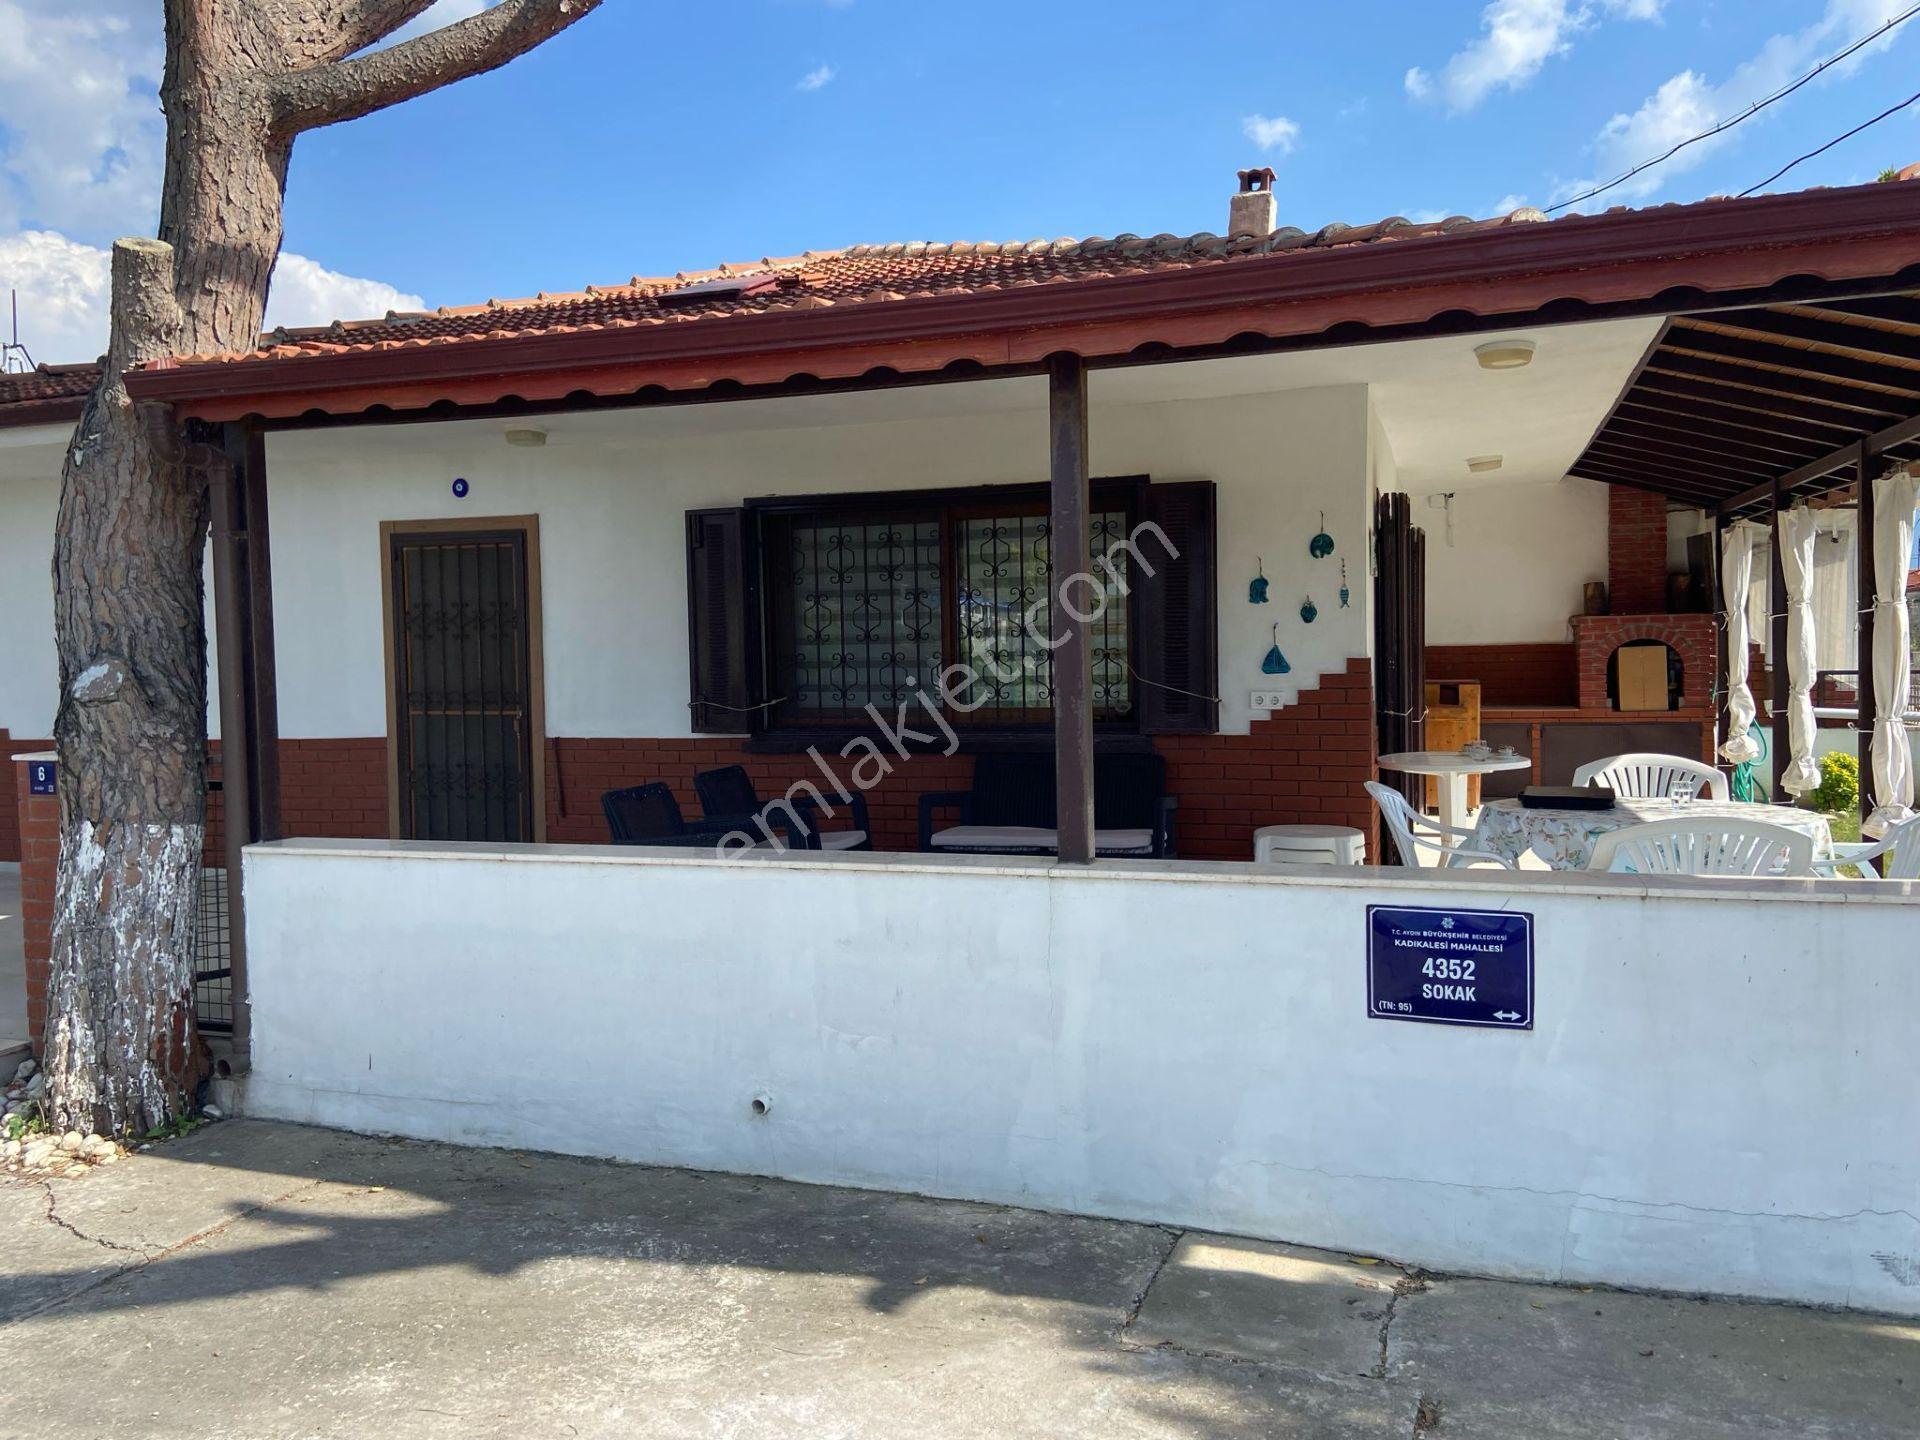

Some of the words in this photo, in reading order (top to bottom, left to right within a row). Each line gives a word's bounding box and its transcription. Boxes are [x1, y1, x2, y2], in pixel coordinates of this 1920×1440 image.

[38, 766, 45, 781] 6
[1422, 930, 1469, 939] BÜYÜKŞEHİR
[1471, 933, 1507, 941] BELEDİYESİ
[1394, 939, 1448, 949] KADIKALESİ
[1450, 942, 1503, 952] MAHALLESİ
[1421, 957, 1476, 981] 4352
[1422, 983, 1476, 1001] SOKAK
[1378, 1000, 1396, 1011] (TN:
[1398, 1002, 1412, 1012] 95)
